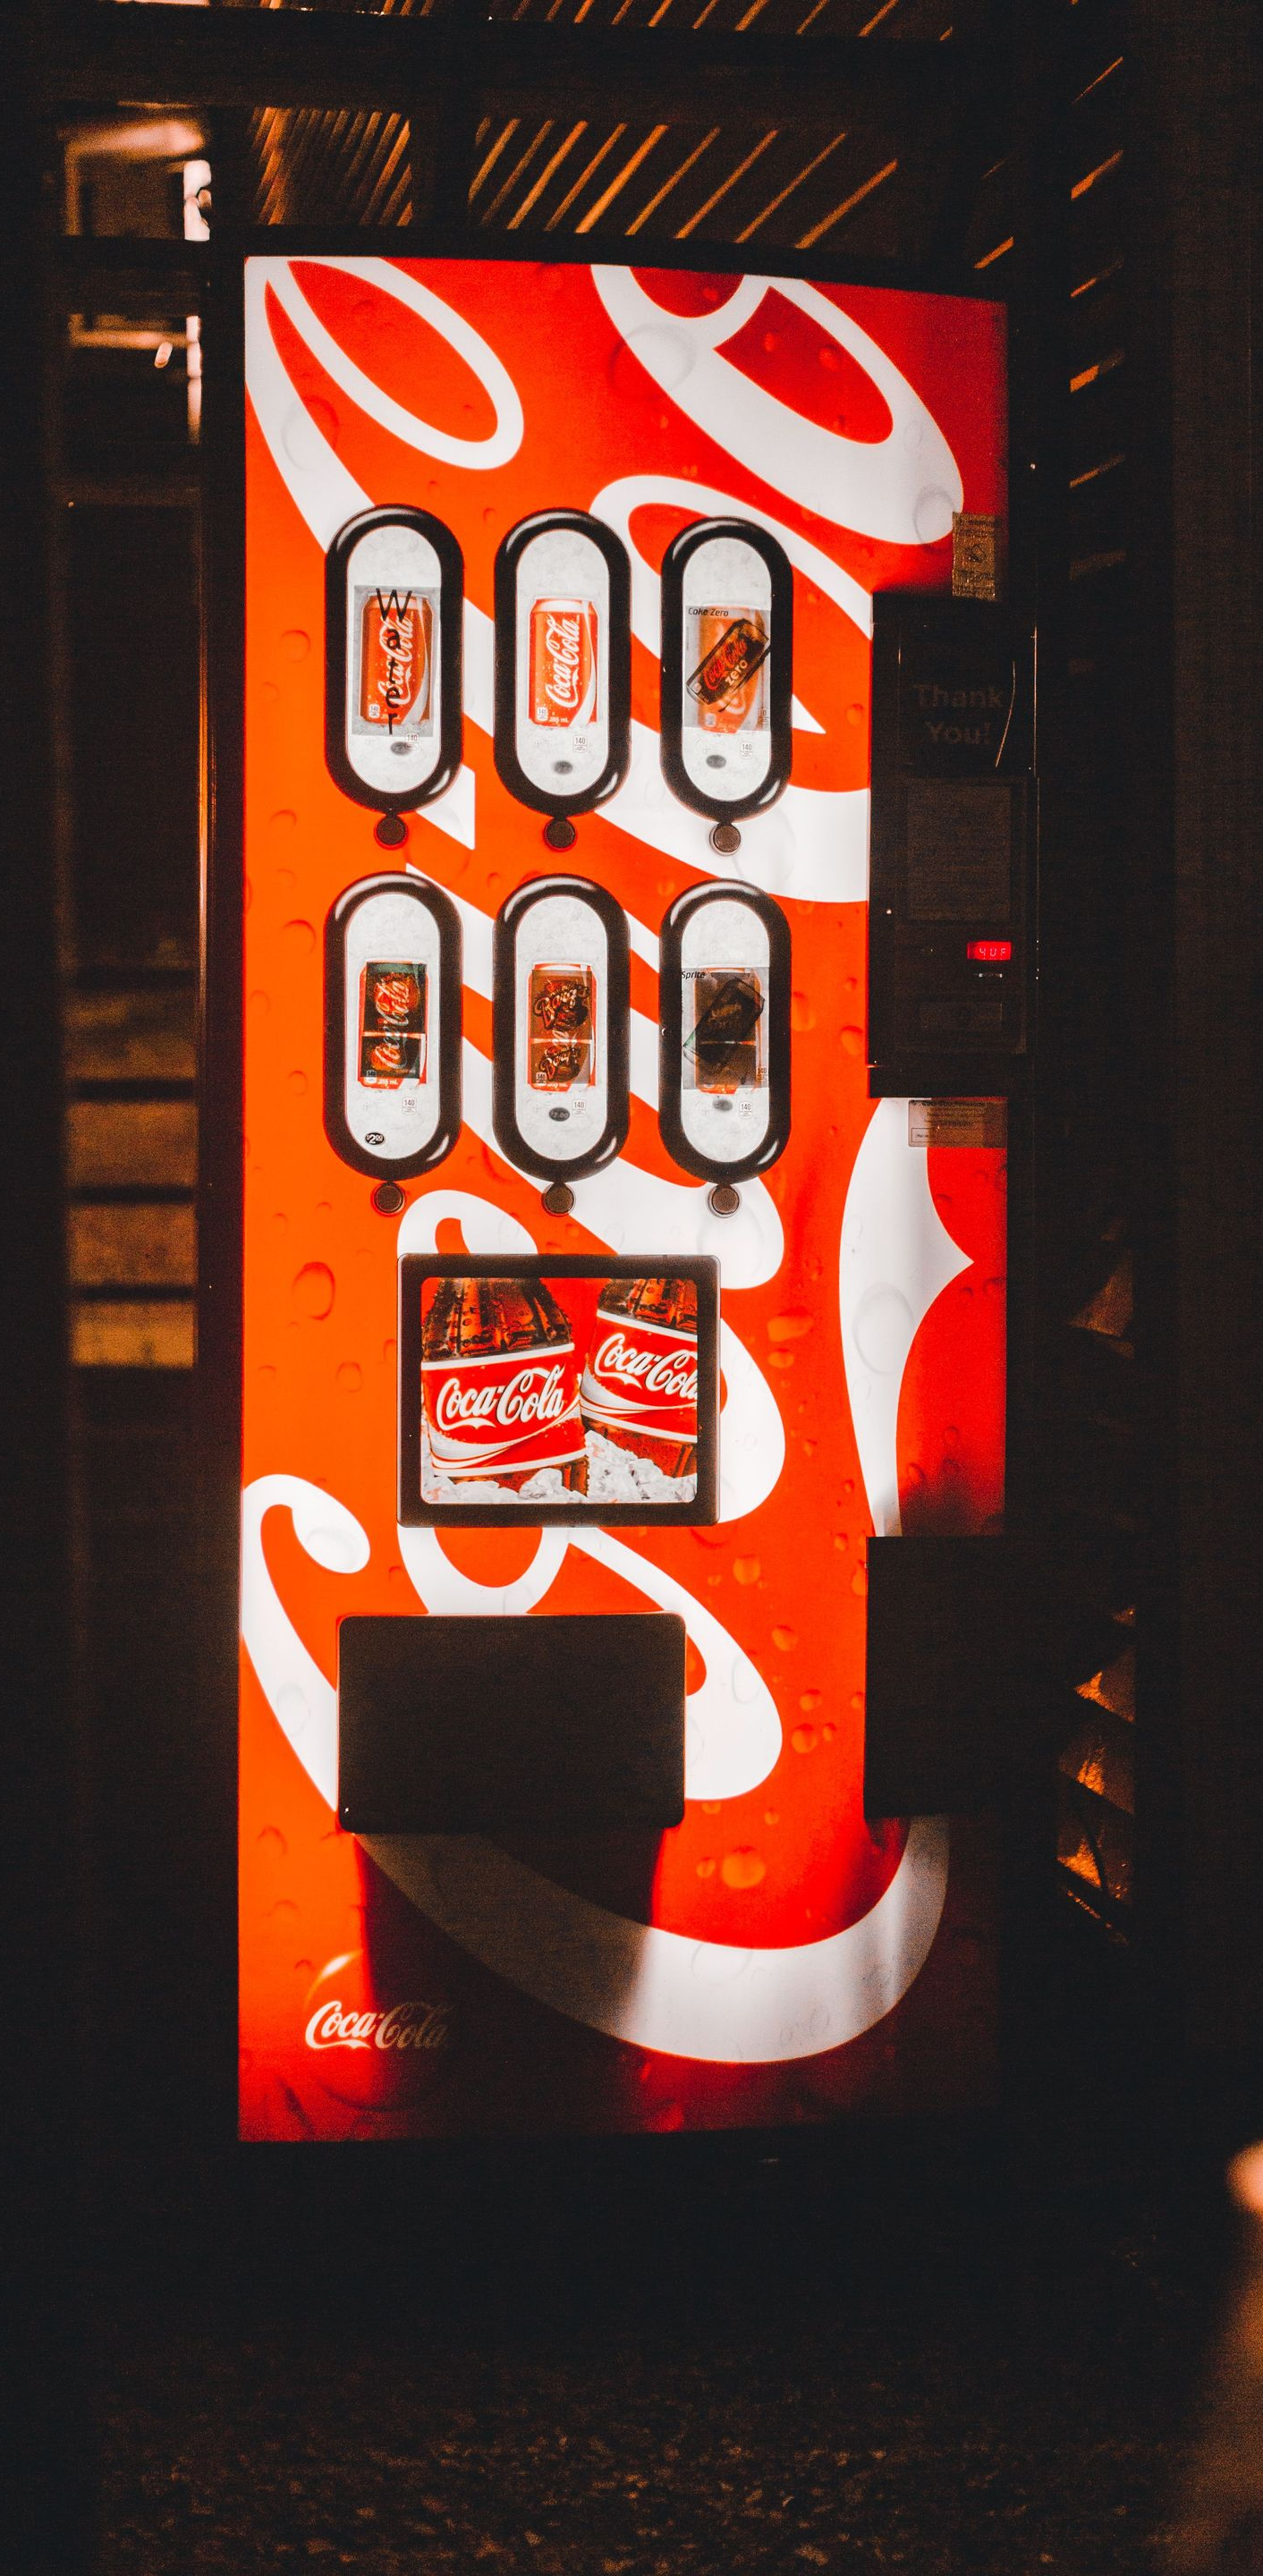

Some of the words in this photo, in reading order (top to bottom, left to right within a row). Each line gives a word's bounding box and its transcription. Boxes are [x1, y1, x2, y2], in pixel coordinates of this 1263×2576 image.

[688, 607, 708, 616] Coke
[710, 608, 729, 617] Zero
[376, 588, 412, 734] Water
[545, 614, 581, 708] Coca-Cola
[725, 658, 748, 686] zero
[912, 684, 1004, 708] Thank
[925, 722, 991, 746] You!
[742, 743, 752, 751] 140
[682, 970, 706, 979] Sprite
[574, 1101, 585, 1109] 140
[741, 1103, 751, 1111] 140
[437, 1362, 566, 1431] Coca-Cola
[305, 2000, 454, 2050] Coca-Cola
